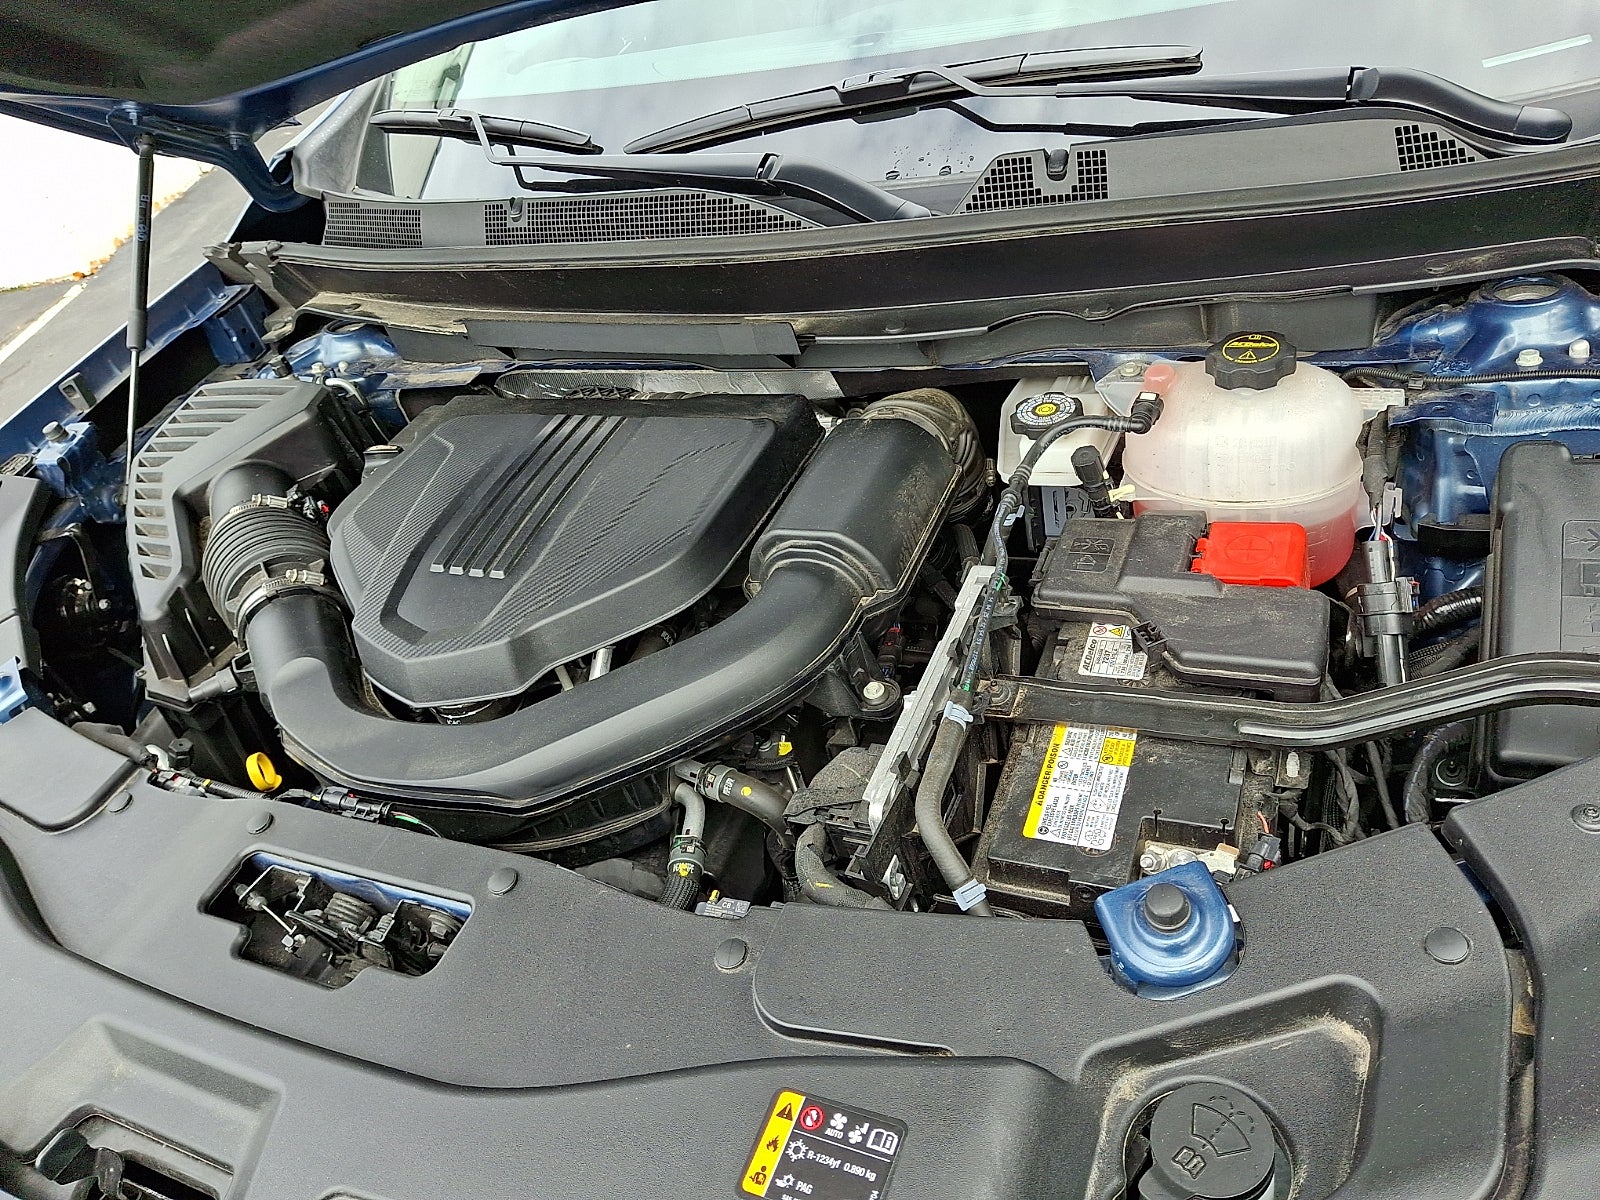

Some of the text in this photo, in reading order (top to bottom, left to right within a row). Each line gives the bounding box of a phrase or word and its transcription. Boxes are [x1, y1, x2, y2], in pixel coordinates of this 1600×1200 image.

[1083, 639, 1097, 671] ACDelco
[824, 1128, 843, 1139] AUTO
[806, 1150, 877, 1182] R-1234yf 0.890 kg
[795, 1181, 813, 1195] PAG
